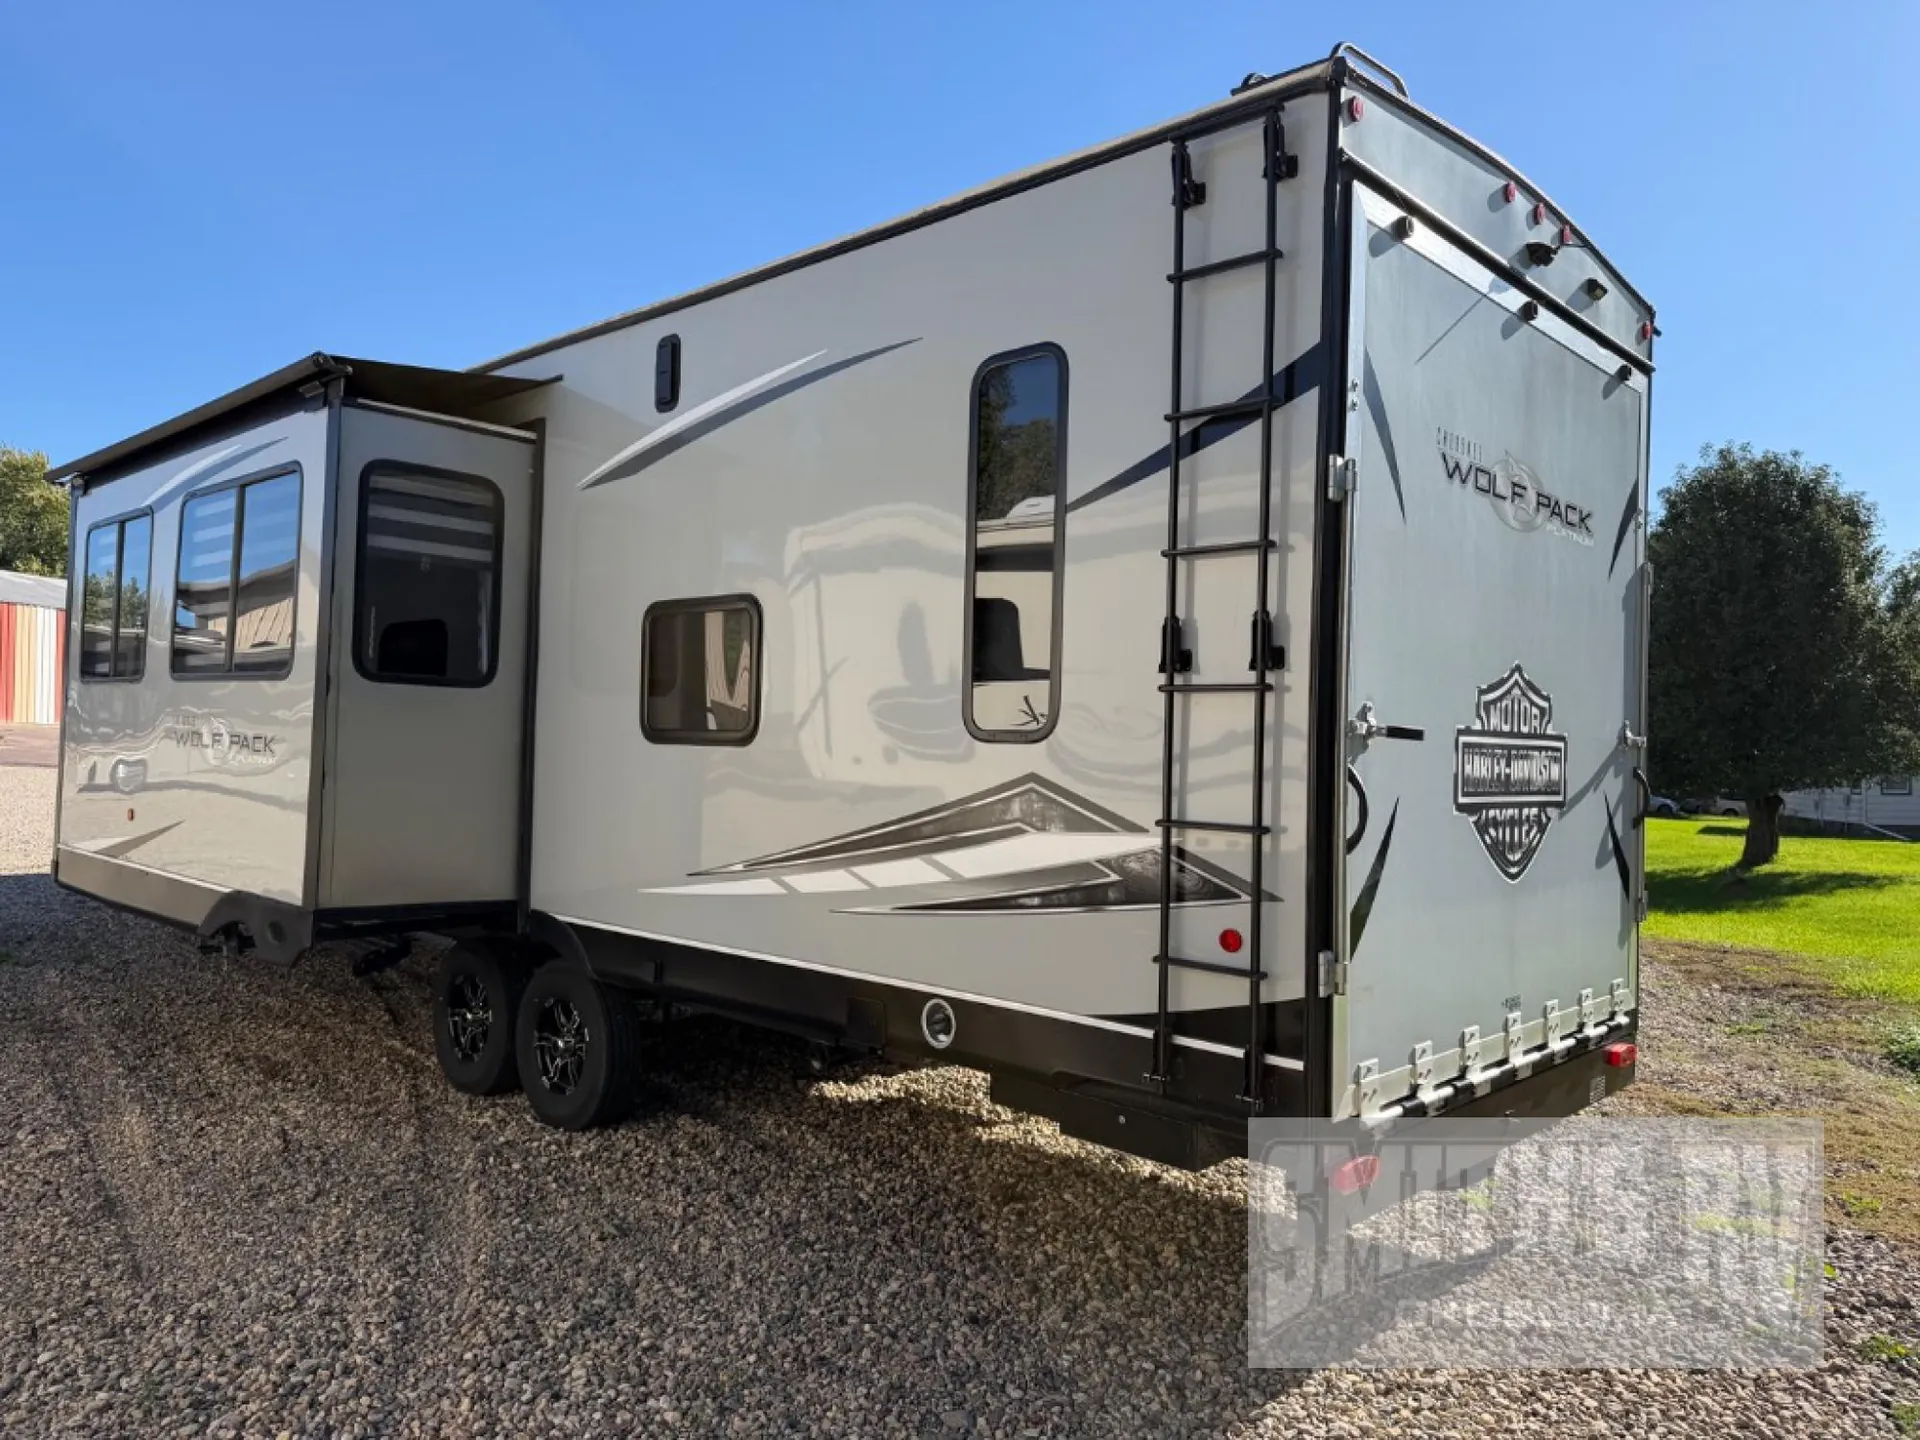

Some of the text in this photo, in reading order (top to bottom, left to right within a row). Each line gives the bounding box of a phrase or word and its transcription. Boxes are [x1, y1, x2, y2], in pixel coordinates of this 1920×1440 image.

[1441, 451, 1593, 534] WOLF PACK
[1489, 694, 1541, 734] MOTOR
[174, 730, 276, 756] WOLF PACK
